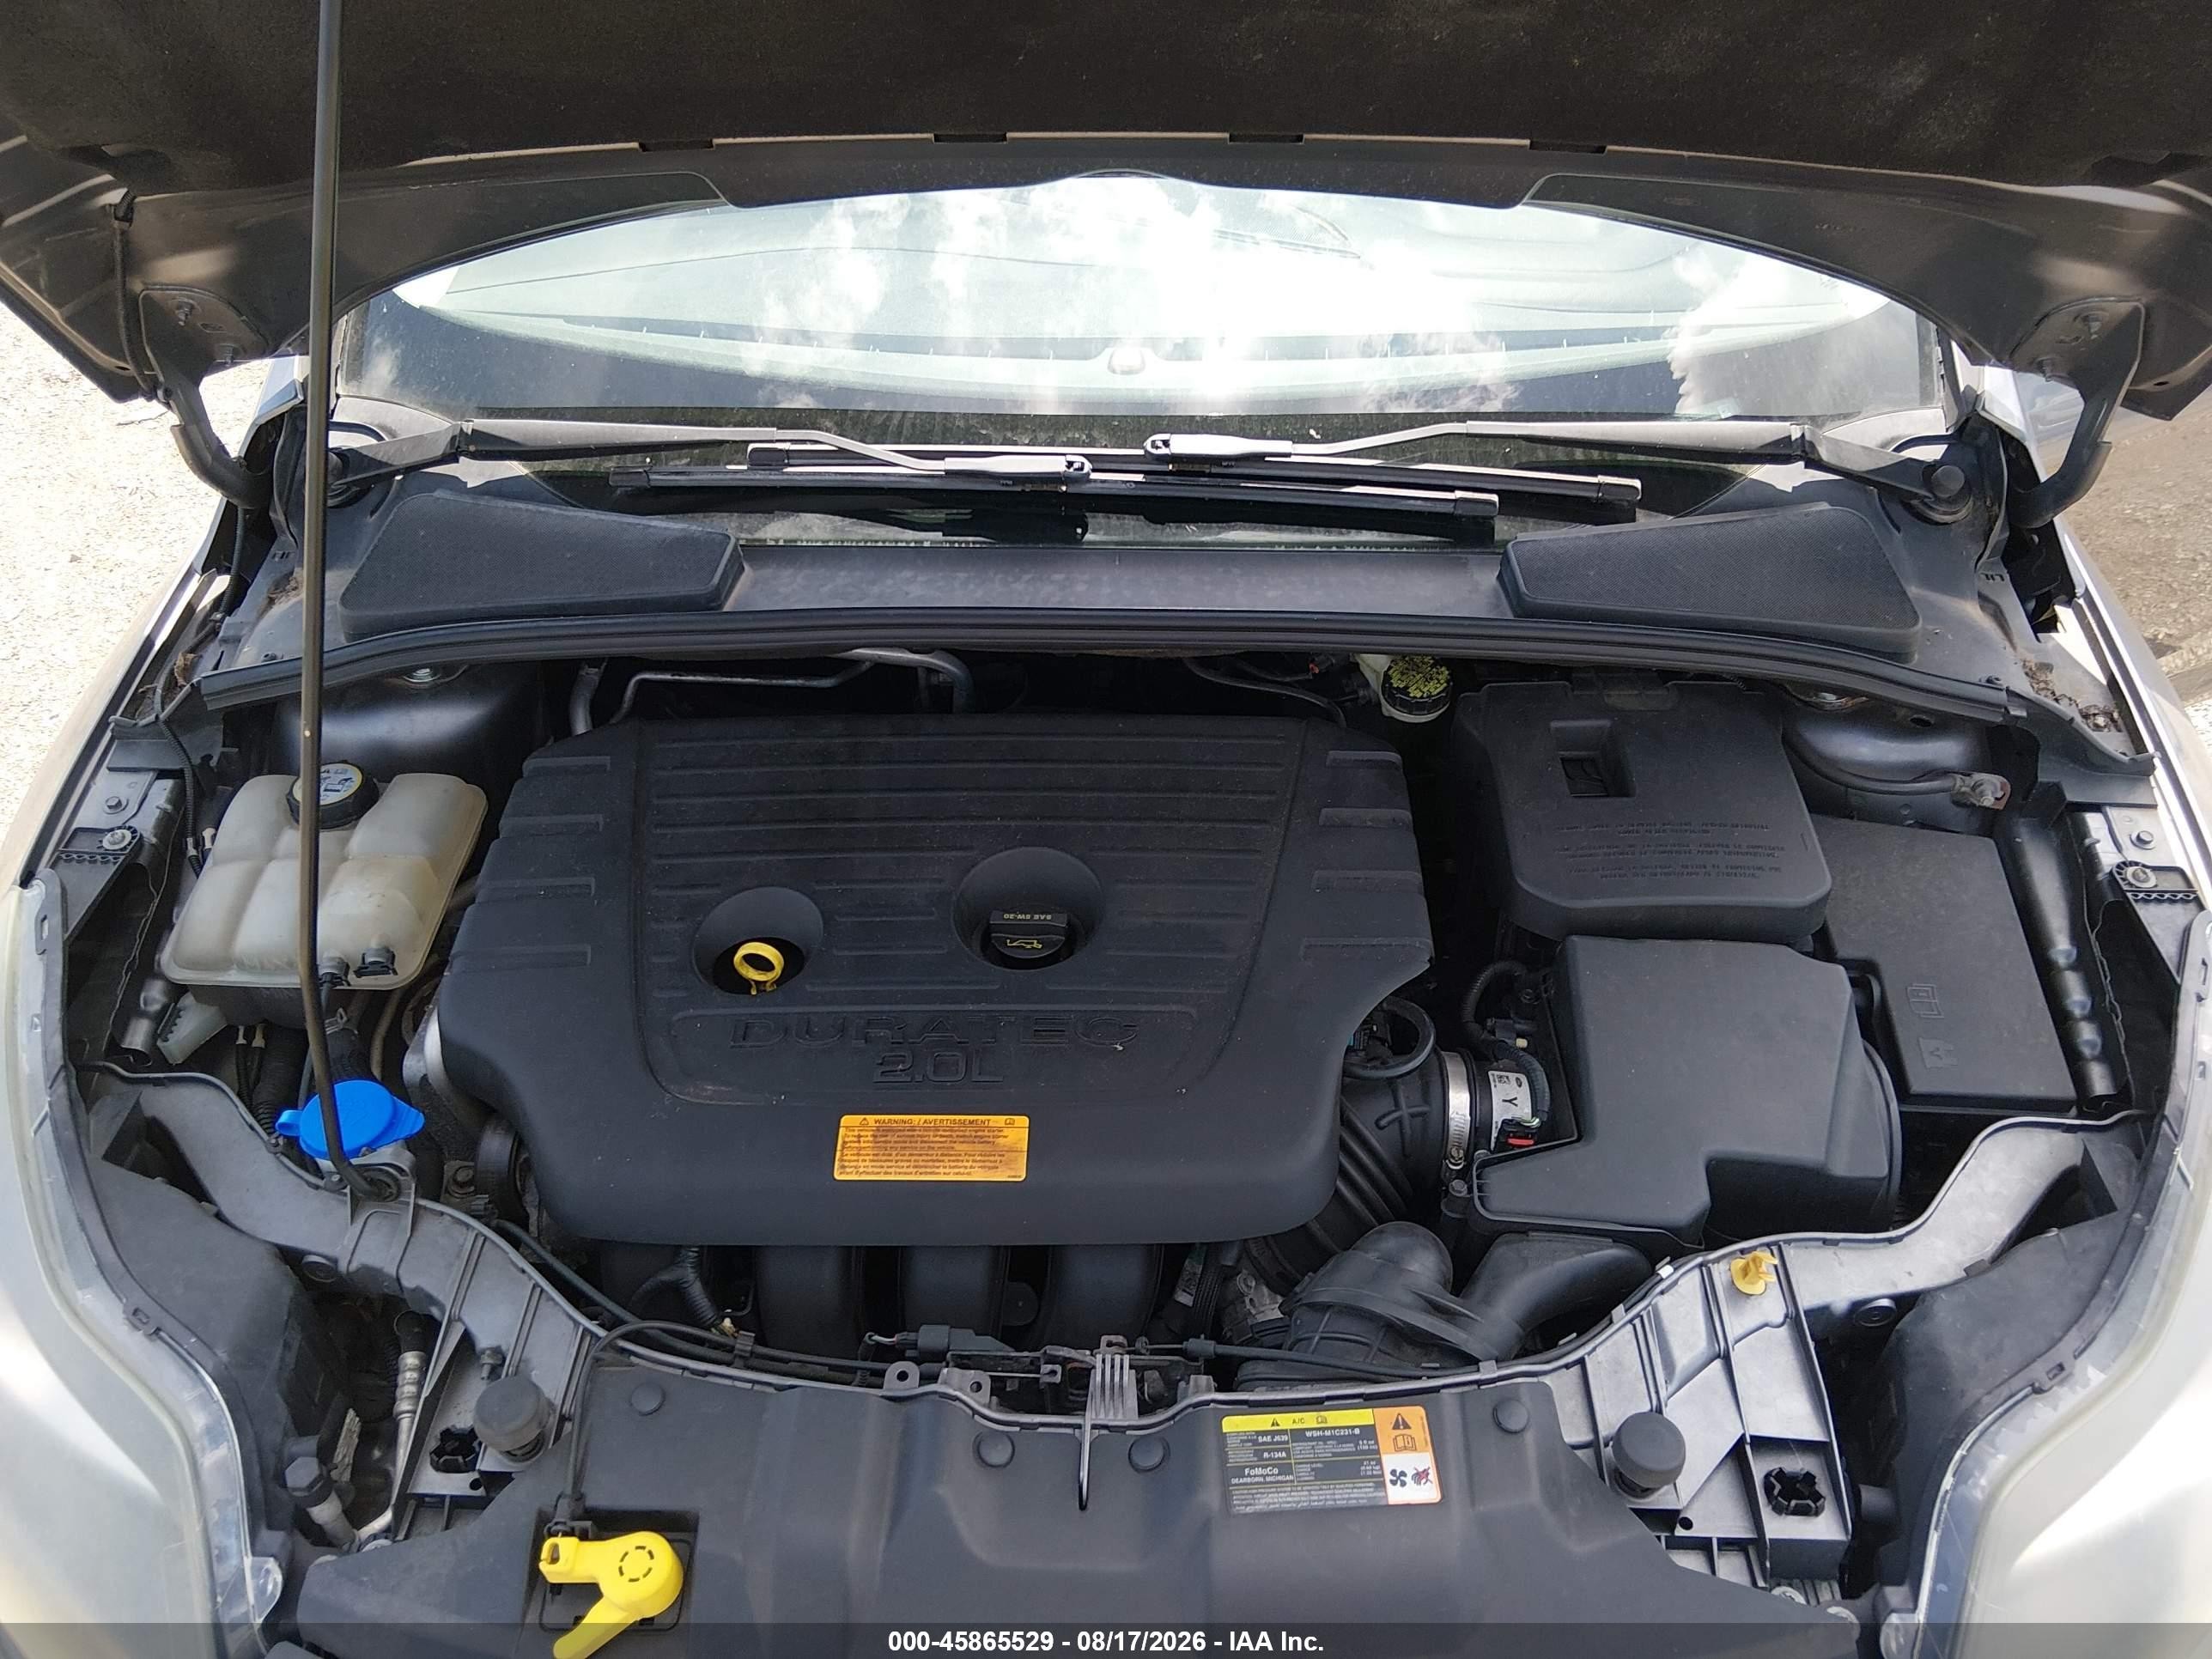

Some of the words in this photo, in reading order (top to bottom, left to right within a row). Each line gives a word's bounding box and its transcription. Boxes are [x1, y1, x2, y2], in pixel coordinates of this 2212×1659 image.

[729, 1015, 1139, 1048] DURATEC
[872, 1049, 1004, 1085] 2.0L
[1501, 1096, 1519, 1108] Y
[922, 1118, 991, 1127] AVERTISSEMENT
[1263, 1450, 1287, 1459] R-134A
[1244, 1466, 1279, 1476] FoMoCo
[1231, 1476, 1265, 1485] DEARBORN,
[1265, 1474, 1294, 1482] MICHIGAN
